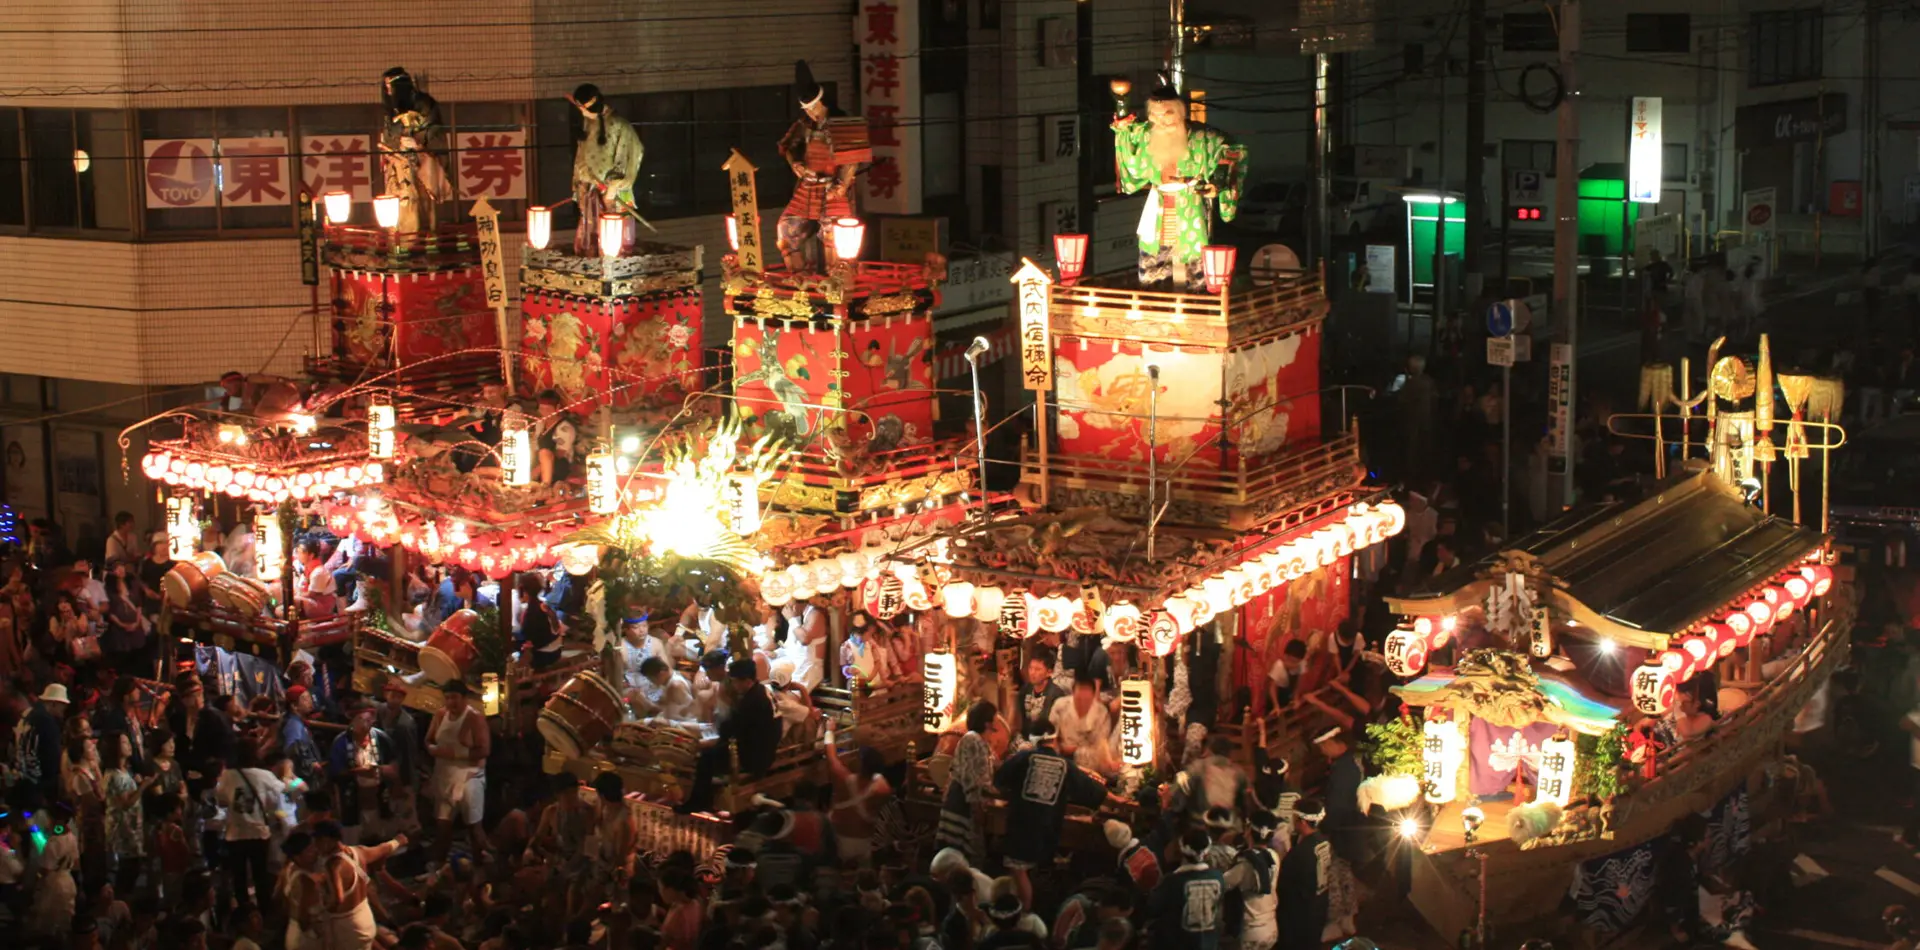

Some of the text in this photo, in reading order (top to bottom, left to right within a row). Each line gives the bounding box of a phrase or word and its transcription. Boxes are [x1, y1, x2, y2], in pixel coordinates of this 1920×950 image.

[159, 186, 202, 201] TOYO
[477, 214, 502, 303] 神功皇后
[1387, 635, 1406, 674] 新宿
[924, 662, 943, 729] 三軒町
[1636, 671, 1659, 712] 新宿
[1122, 690, 1143, 760] 三軒町
[1424, 734, 1444, 798] 神明丸
